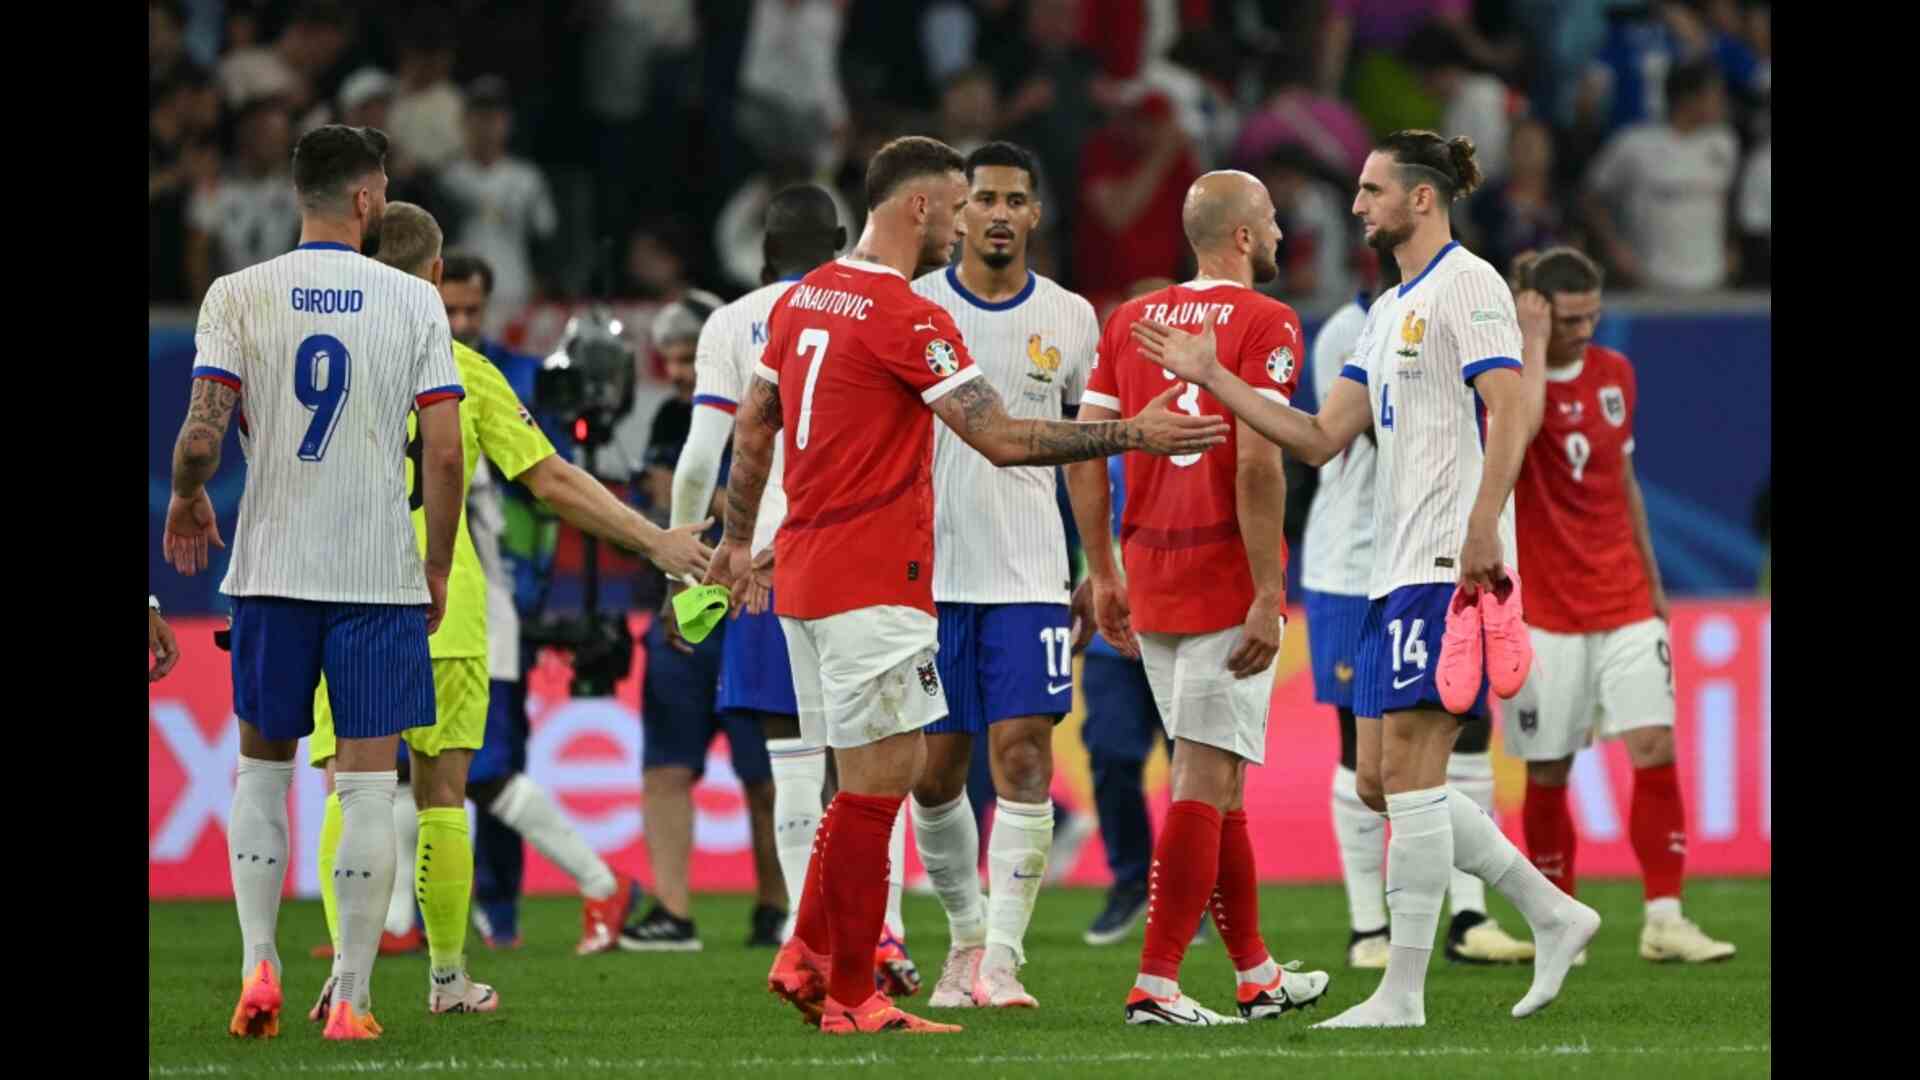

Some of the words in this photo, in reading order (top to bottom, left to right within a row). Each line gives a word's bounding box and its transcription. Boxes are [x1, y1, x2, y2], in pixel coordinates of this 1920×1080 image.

[291, 287, 364, 314] GIROUD
[294, 333, 352, 462] 9
[796, 328, 830, 450] 7
[1565, 431, 1591, 482] 9
[1040, 627, 1072, 677] 17
[1388, 618, 1428, 672] 14
